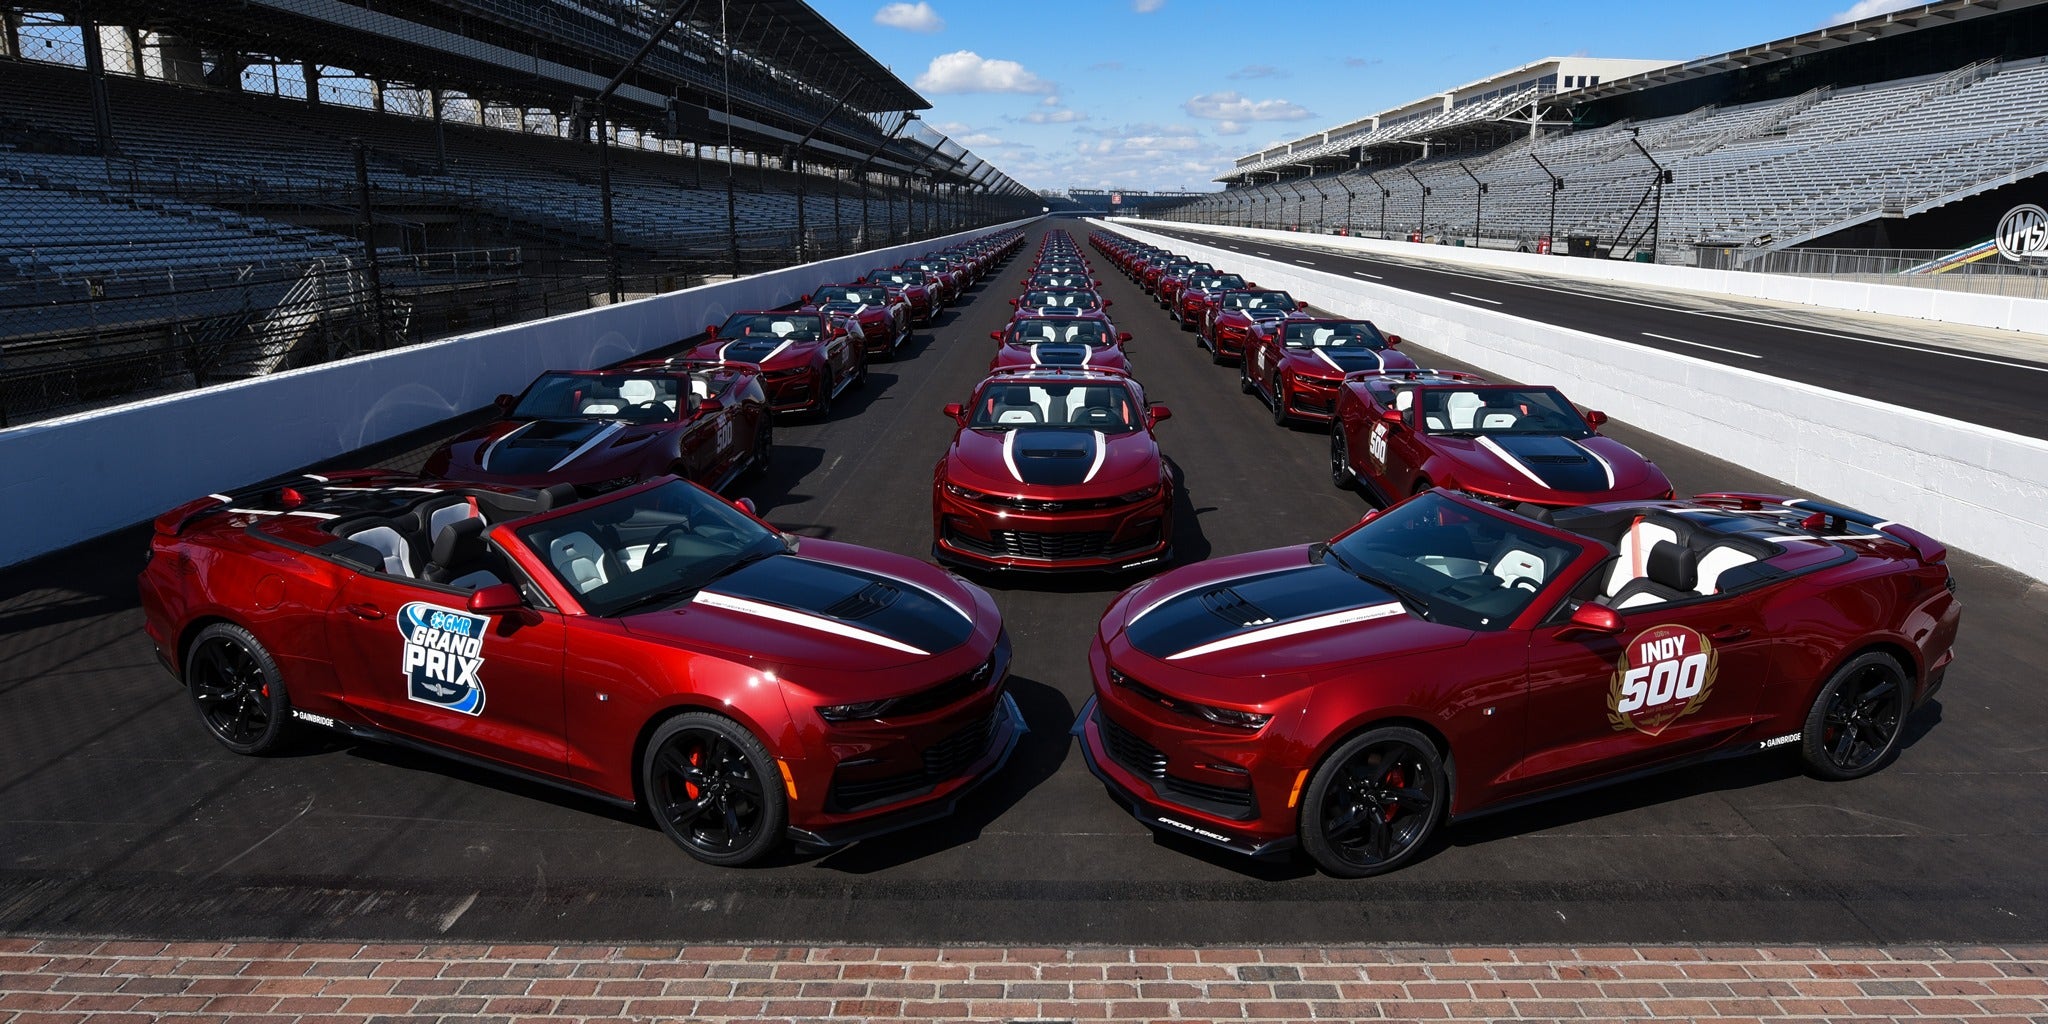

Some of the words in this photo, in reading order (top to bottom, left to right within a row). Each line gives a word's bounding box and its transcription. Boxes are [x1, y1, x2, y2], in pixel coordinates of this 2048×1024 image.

[2005, 211, 2045, 253] IMS
[1370, 431, 1386, 464] 500
[443, 614, 471, 636] GMR
[412, 626, 480, 658] GRAND
[1641, 634, 1686, 665] INDY
[406, 643, 479, 689] PRIX
[1618, 653, 1708, 713] 500
[299, 711, 334, 728] GAINBRIDGE
[1766, 732, 1802, 748] GAINBRIDGE
[1158, 817, 1194, 831] OFFICIAL
[1194, 828, 1231, 843] VEHICLE
